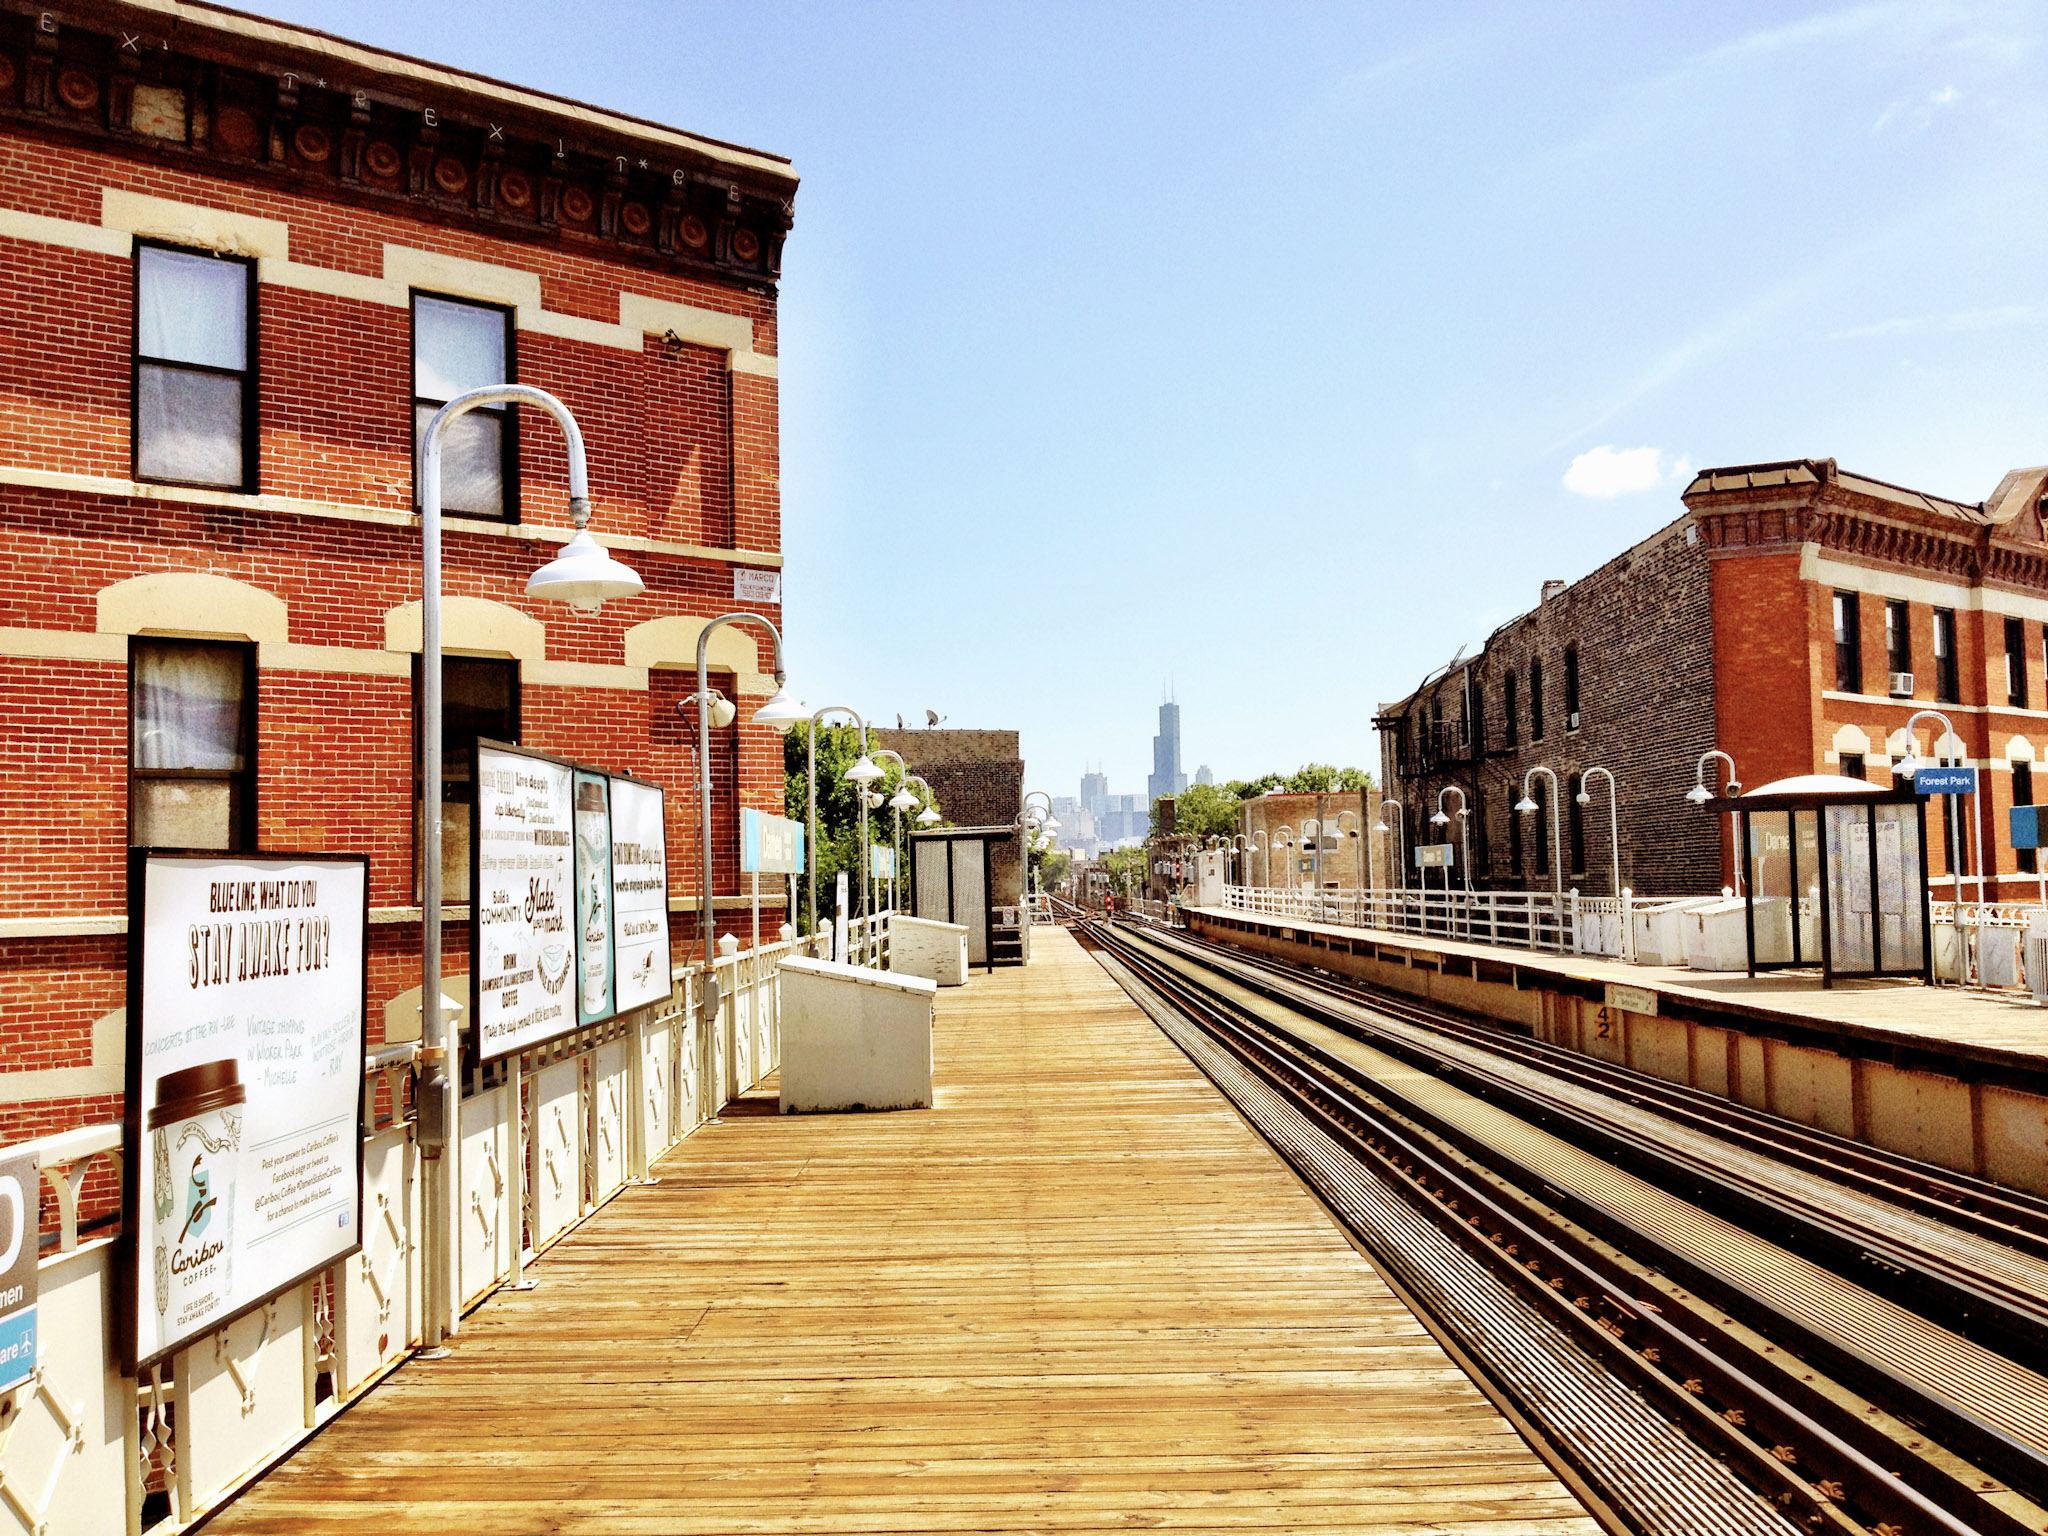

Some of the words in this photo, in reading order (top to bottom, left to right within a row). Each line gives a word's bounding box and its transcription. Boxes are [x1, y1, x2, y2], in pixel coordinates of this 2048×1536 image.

[748, 572, 774, 583] MARCO
[1919, 776, 1949, 786] Forest
[1950, 776, 1971, 786] Park
[1765, 831, 1790, 851] Dame
[210, 881, 235, 913] BLUE
[236, 880, 257, 915] LINE,
[260, 880, 286, 910] WHAT
[287, 880, 301, 909] DO
[301, 879, 318, 908] YOU
[188, 922, 233, 990] STAY
[237, 917, 291, 983] AWAKE
[296, 914, 330, 975] FOR?
[1597, 1006, 1609, 1022] 4
[1597, 1022, 1610, 1039] 2
[171, 1240, 224, 1275] Caribou
[183, 1264, 214, 1288] COFFEE
[177, 1317, 190, 1327] STAY
[189, 1307, 205, 1322] AWAKE
[204, 1302, 215, 1313] FOR
[183, 1303, 194, 1314] LIFE
